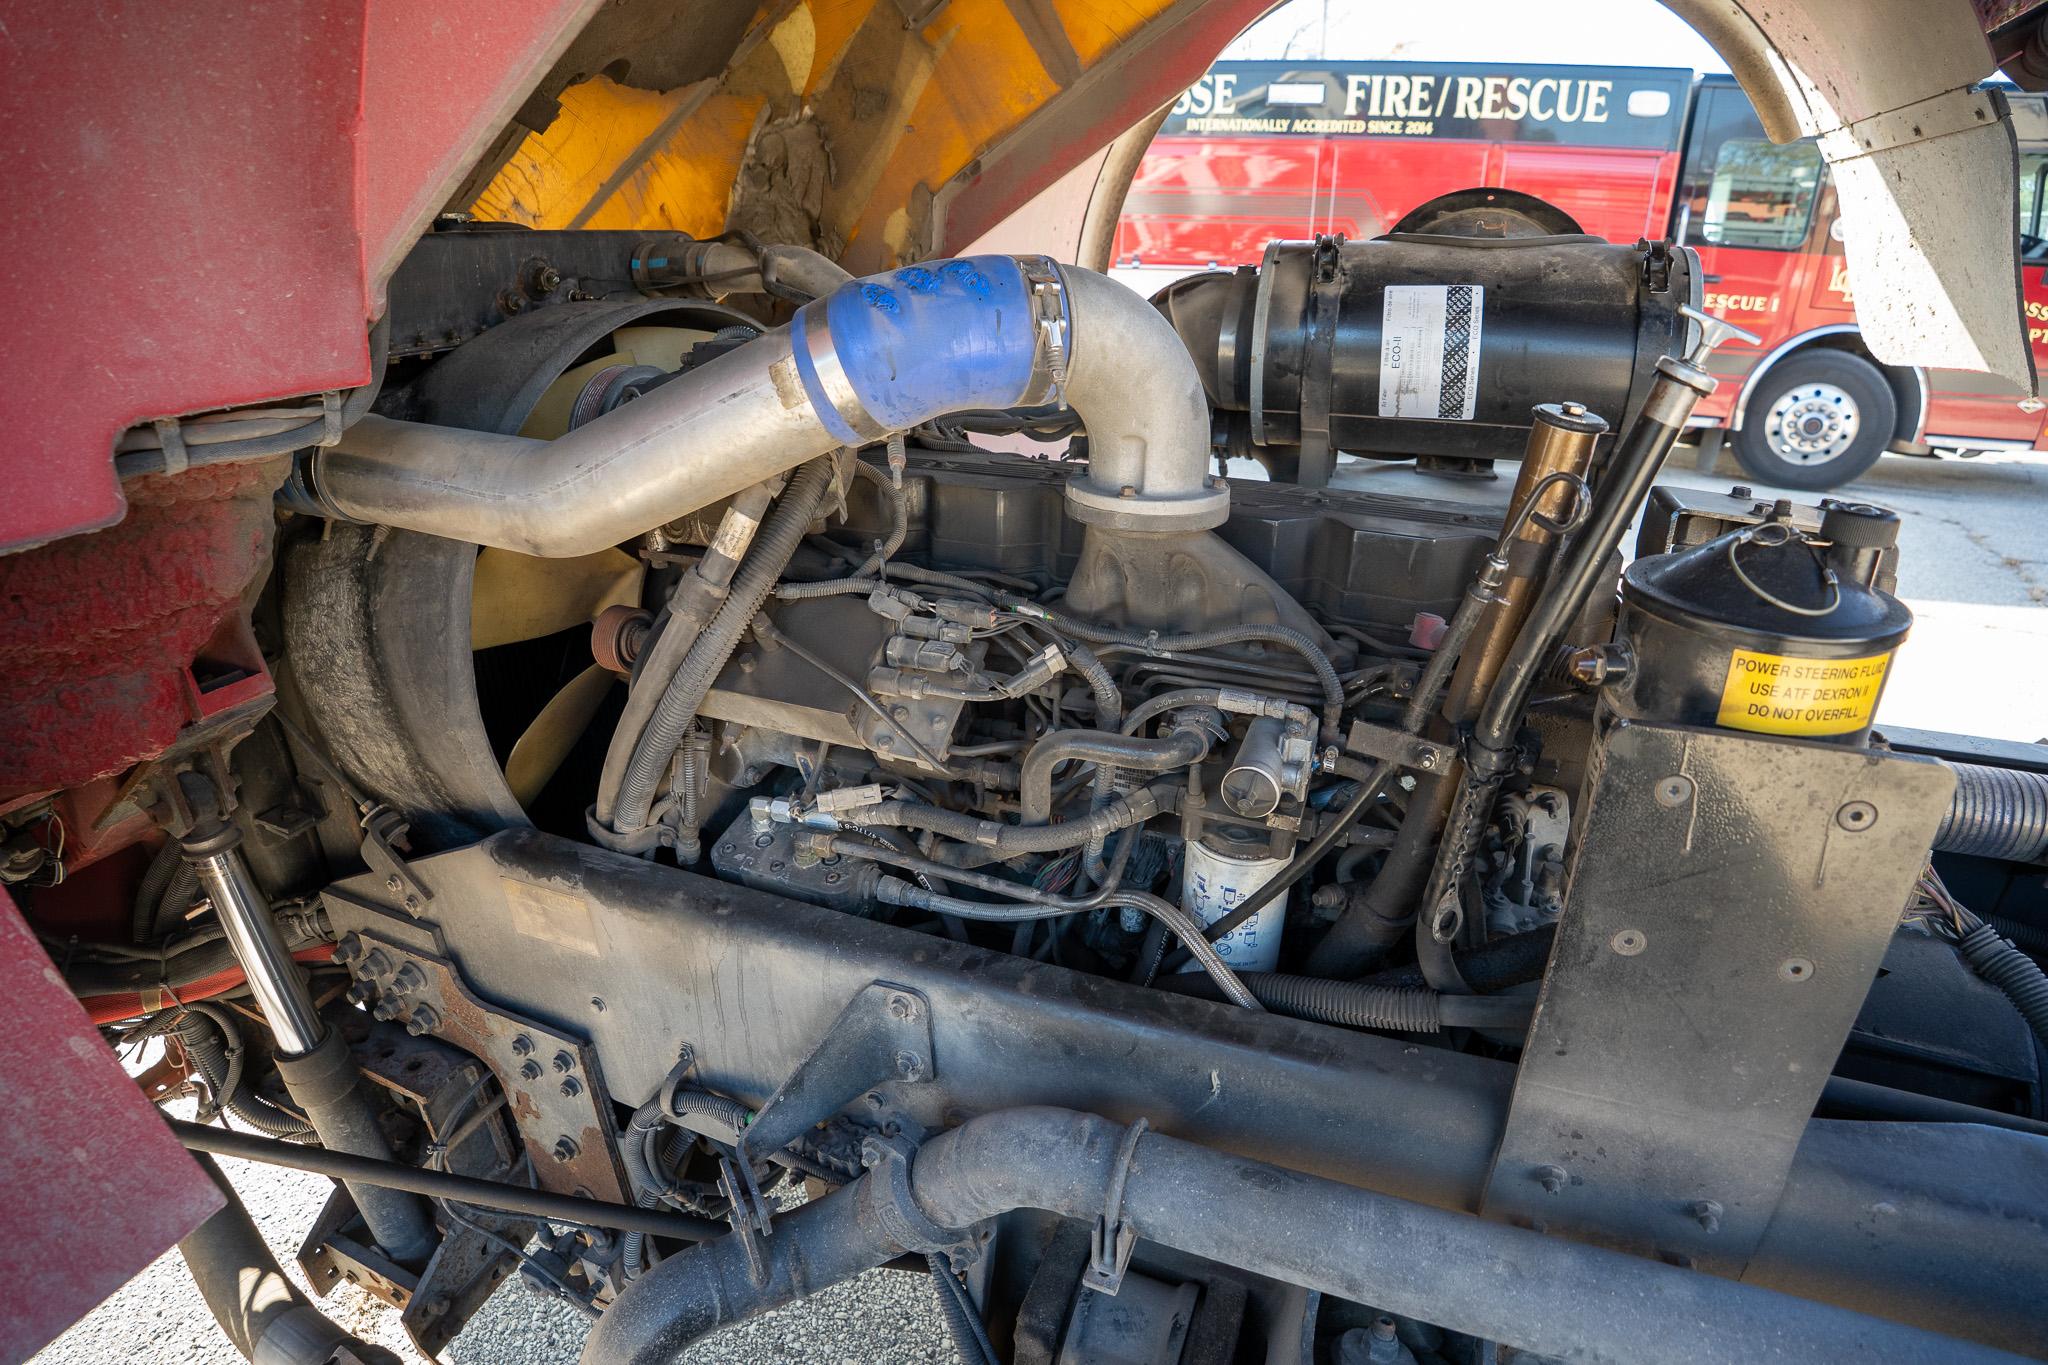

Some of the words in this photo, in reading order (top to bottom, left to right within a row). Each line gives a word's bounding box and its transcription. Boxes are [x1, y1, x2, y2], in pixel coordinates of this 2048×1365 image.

[1344, 75, 1612, 122] FIRE/RESCUE
[1187, 117, 1291, 132] INTERNATIONALLY
[1292, 119, 1366, 133] ACCREDITED
[1367, 119, 1404, 134] SINCE
[1405, 120, 1434, 135] 2014
[1703, 293, 1768, 312] ESCUE
[1392, 336, 1402, 369] ECO-II
[1736, 658, 1790, 678] POWER
[1794, 666, 1858, 681] STEERING
[1860, 662, 1885, 677] FLUID
[1750, 682, 1777, 697] USE
[1783, 687, 1810, 700] ATF
[1813, 686, 1861, 701] DEXRON
[1862, 685, 1869, 697] II
[1748, 703, 1769, 717] DO
[1772, 706, 1801, 720] NOT
[1805, 705, 1858, 721] OVERFILL
